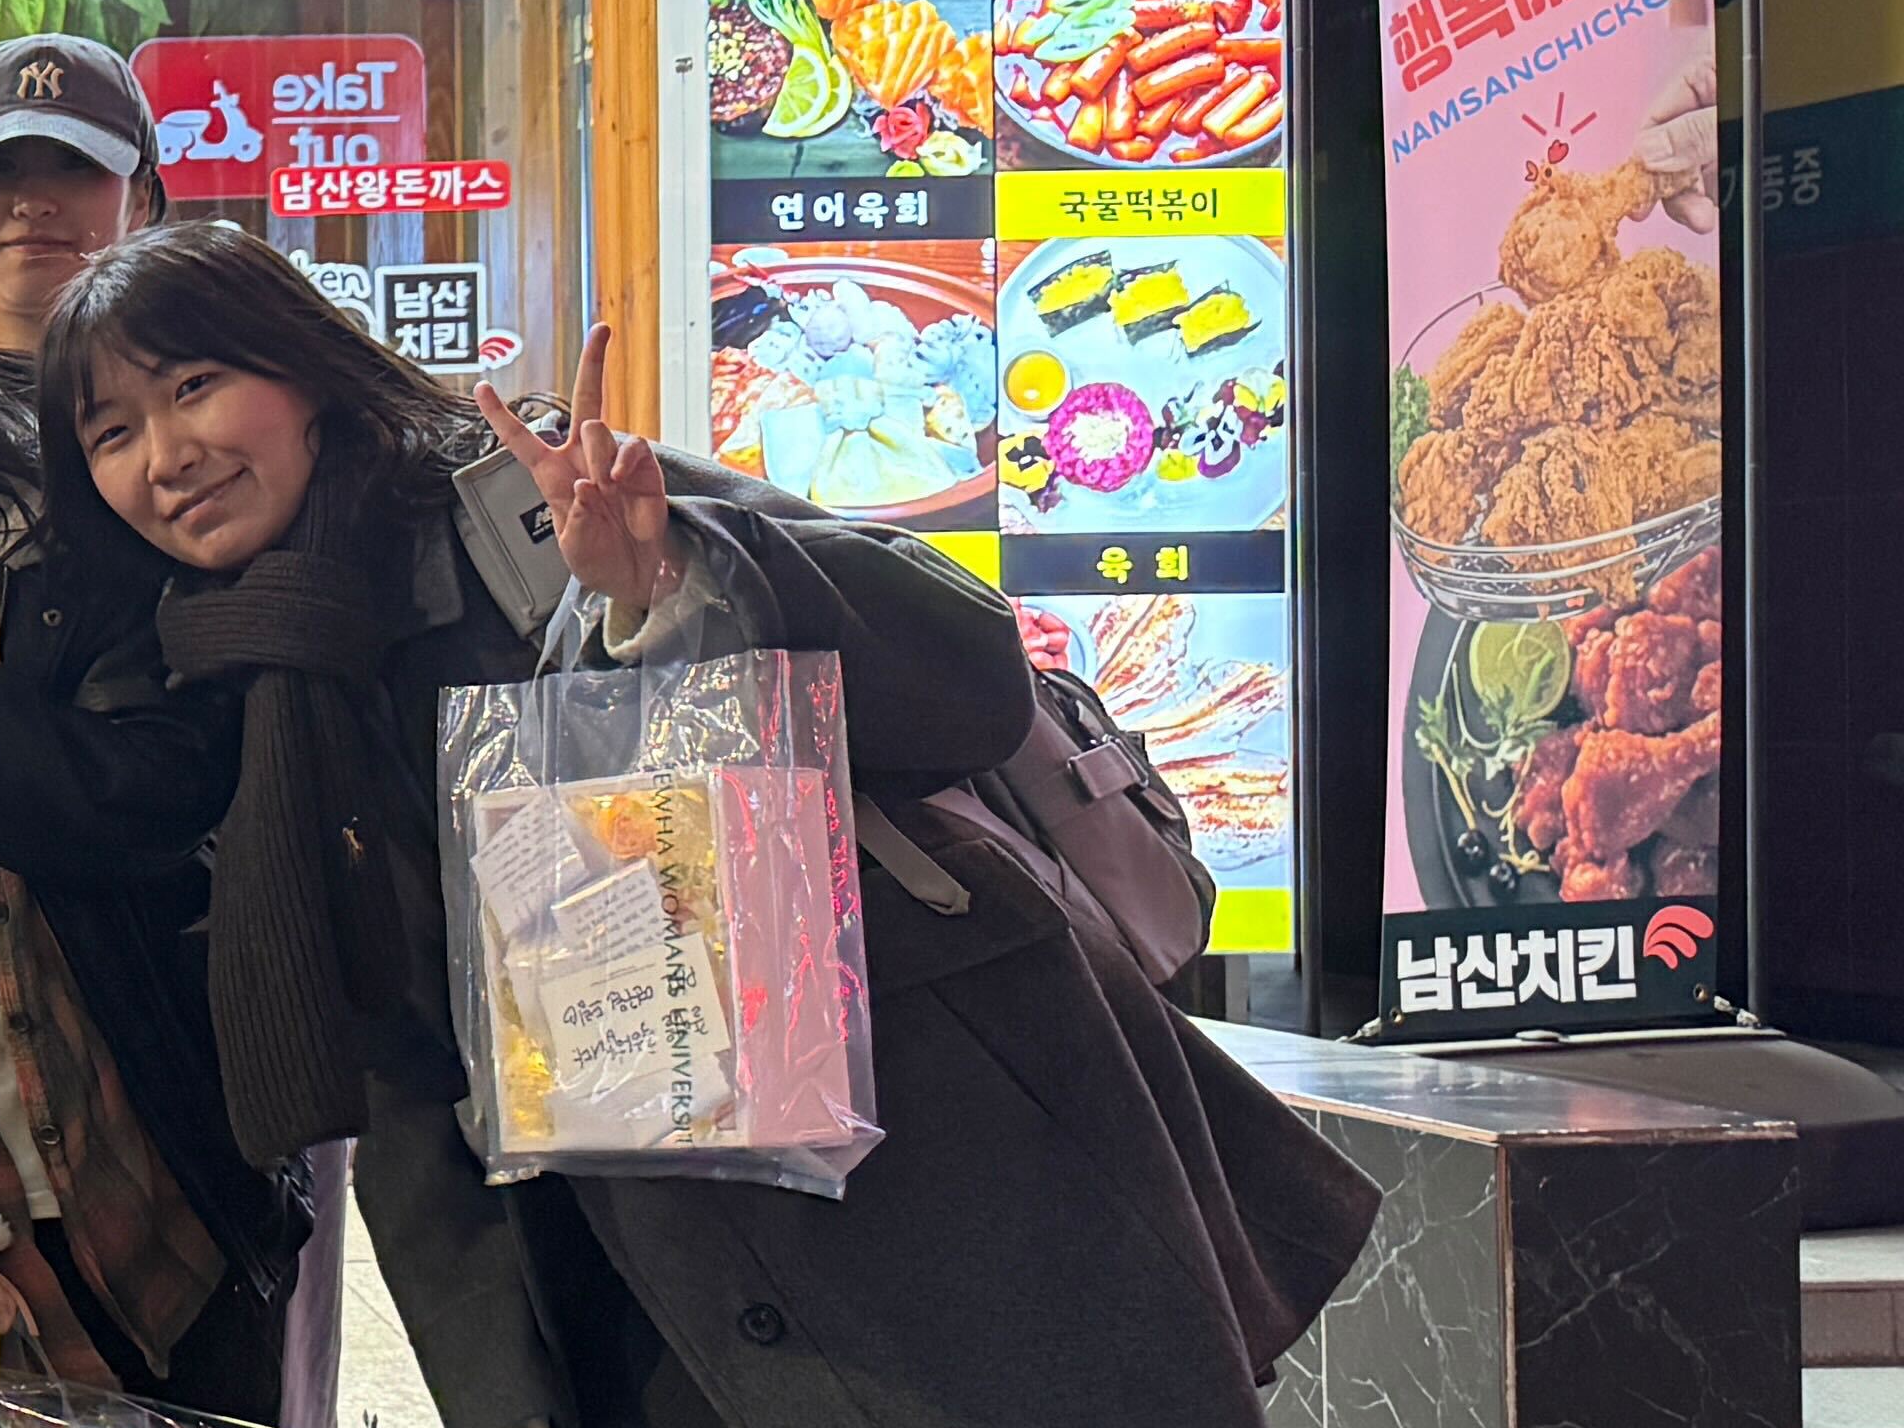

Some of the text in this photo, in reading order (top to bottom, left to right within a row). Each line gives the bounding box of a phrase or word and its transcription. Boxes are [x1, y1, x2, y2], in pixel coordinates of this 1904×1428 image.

[280, 167, 505, 211] 남산왕돈까스
[1060, 188, 1220, 222] 국물떡볶이
[771, 190, 930, 229] 연어육회
[394, 279, 472, 318] 남산
[394, 324, 469, 360] 치킨
[653, 771, 674, 856] EWHA
[1396, 925, 1638, 1014] 남산치킨
